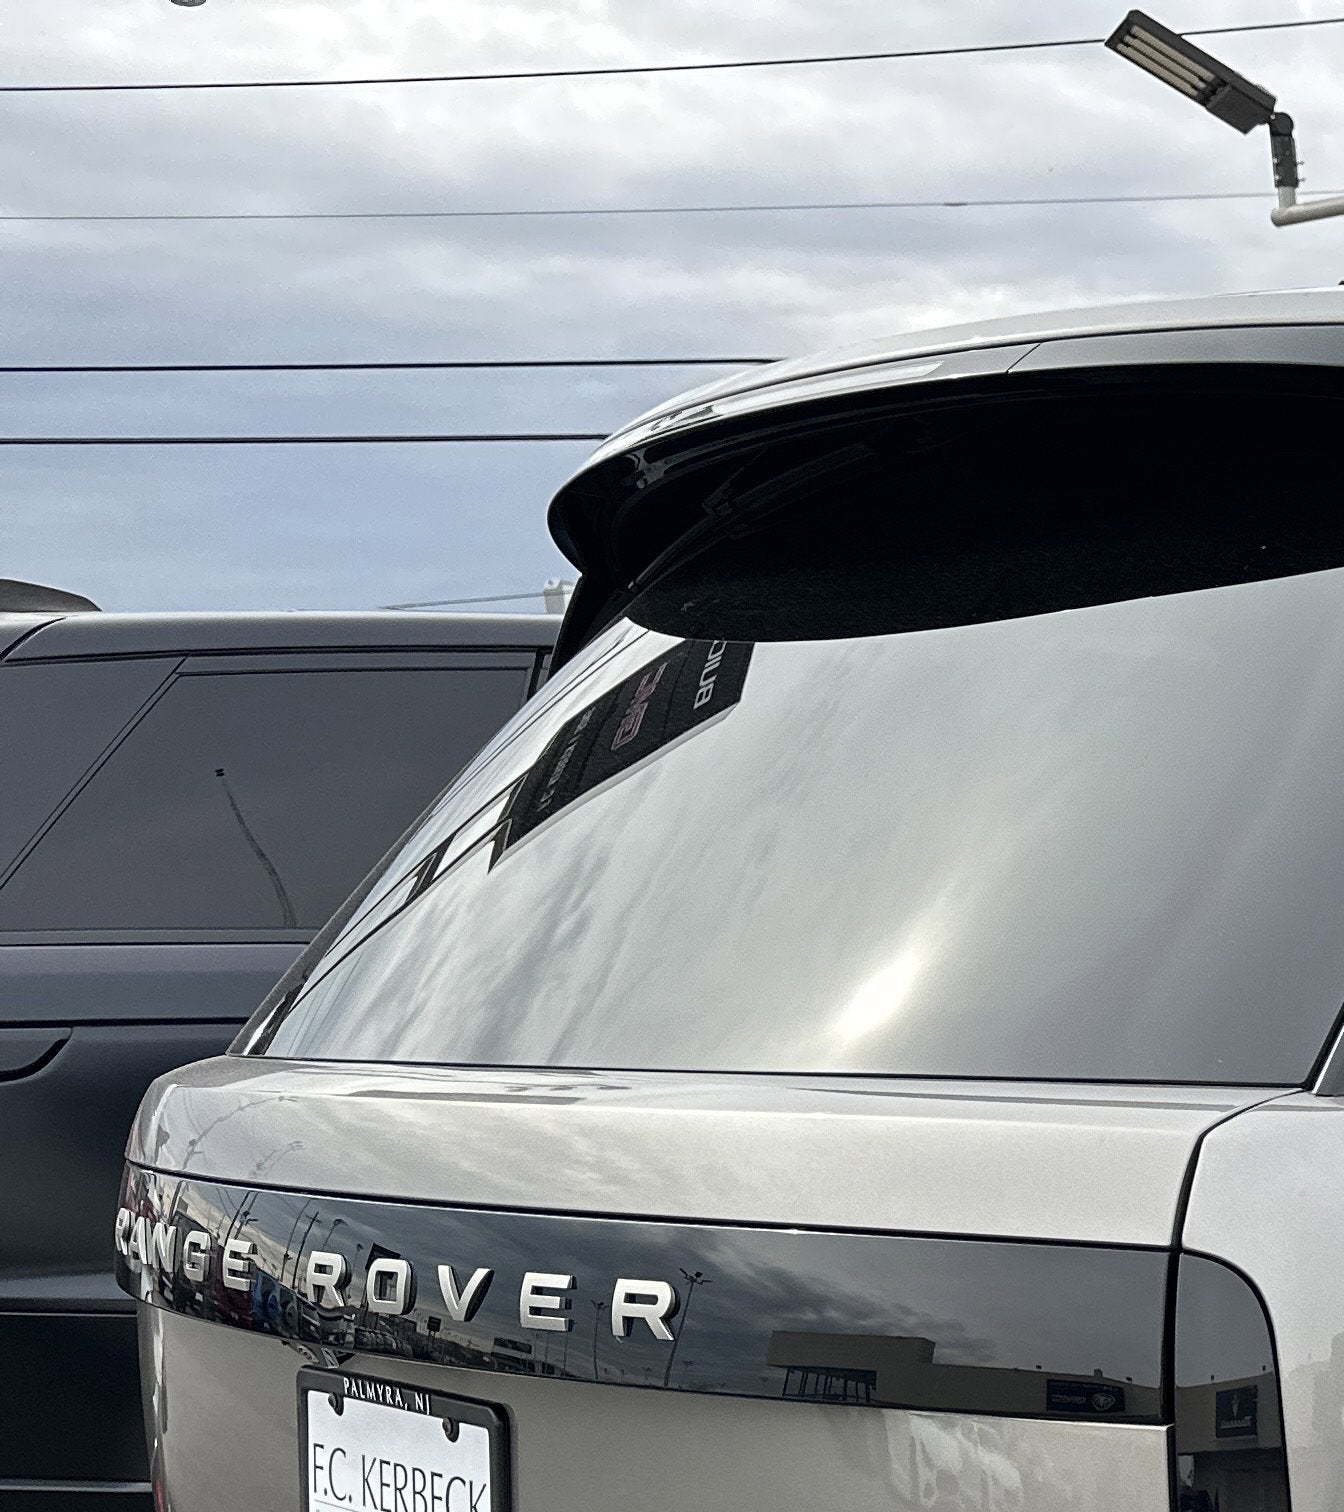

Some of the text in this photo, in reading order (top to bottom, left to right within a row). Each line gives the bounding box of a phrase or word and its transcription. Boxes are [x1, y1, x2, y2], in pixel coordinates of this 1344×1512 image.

[115, 1207, 680, 1342] RANGE ROVER
[342, 1376, 409, 1411] PALMYRA,
[313, 1442, 353, 1504] F.C.
